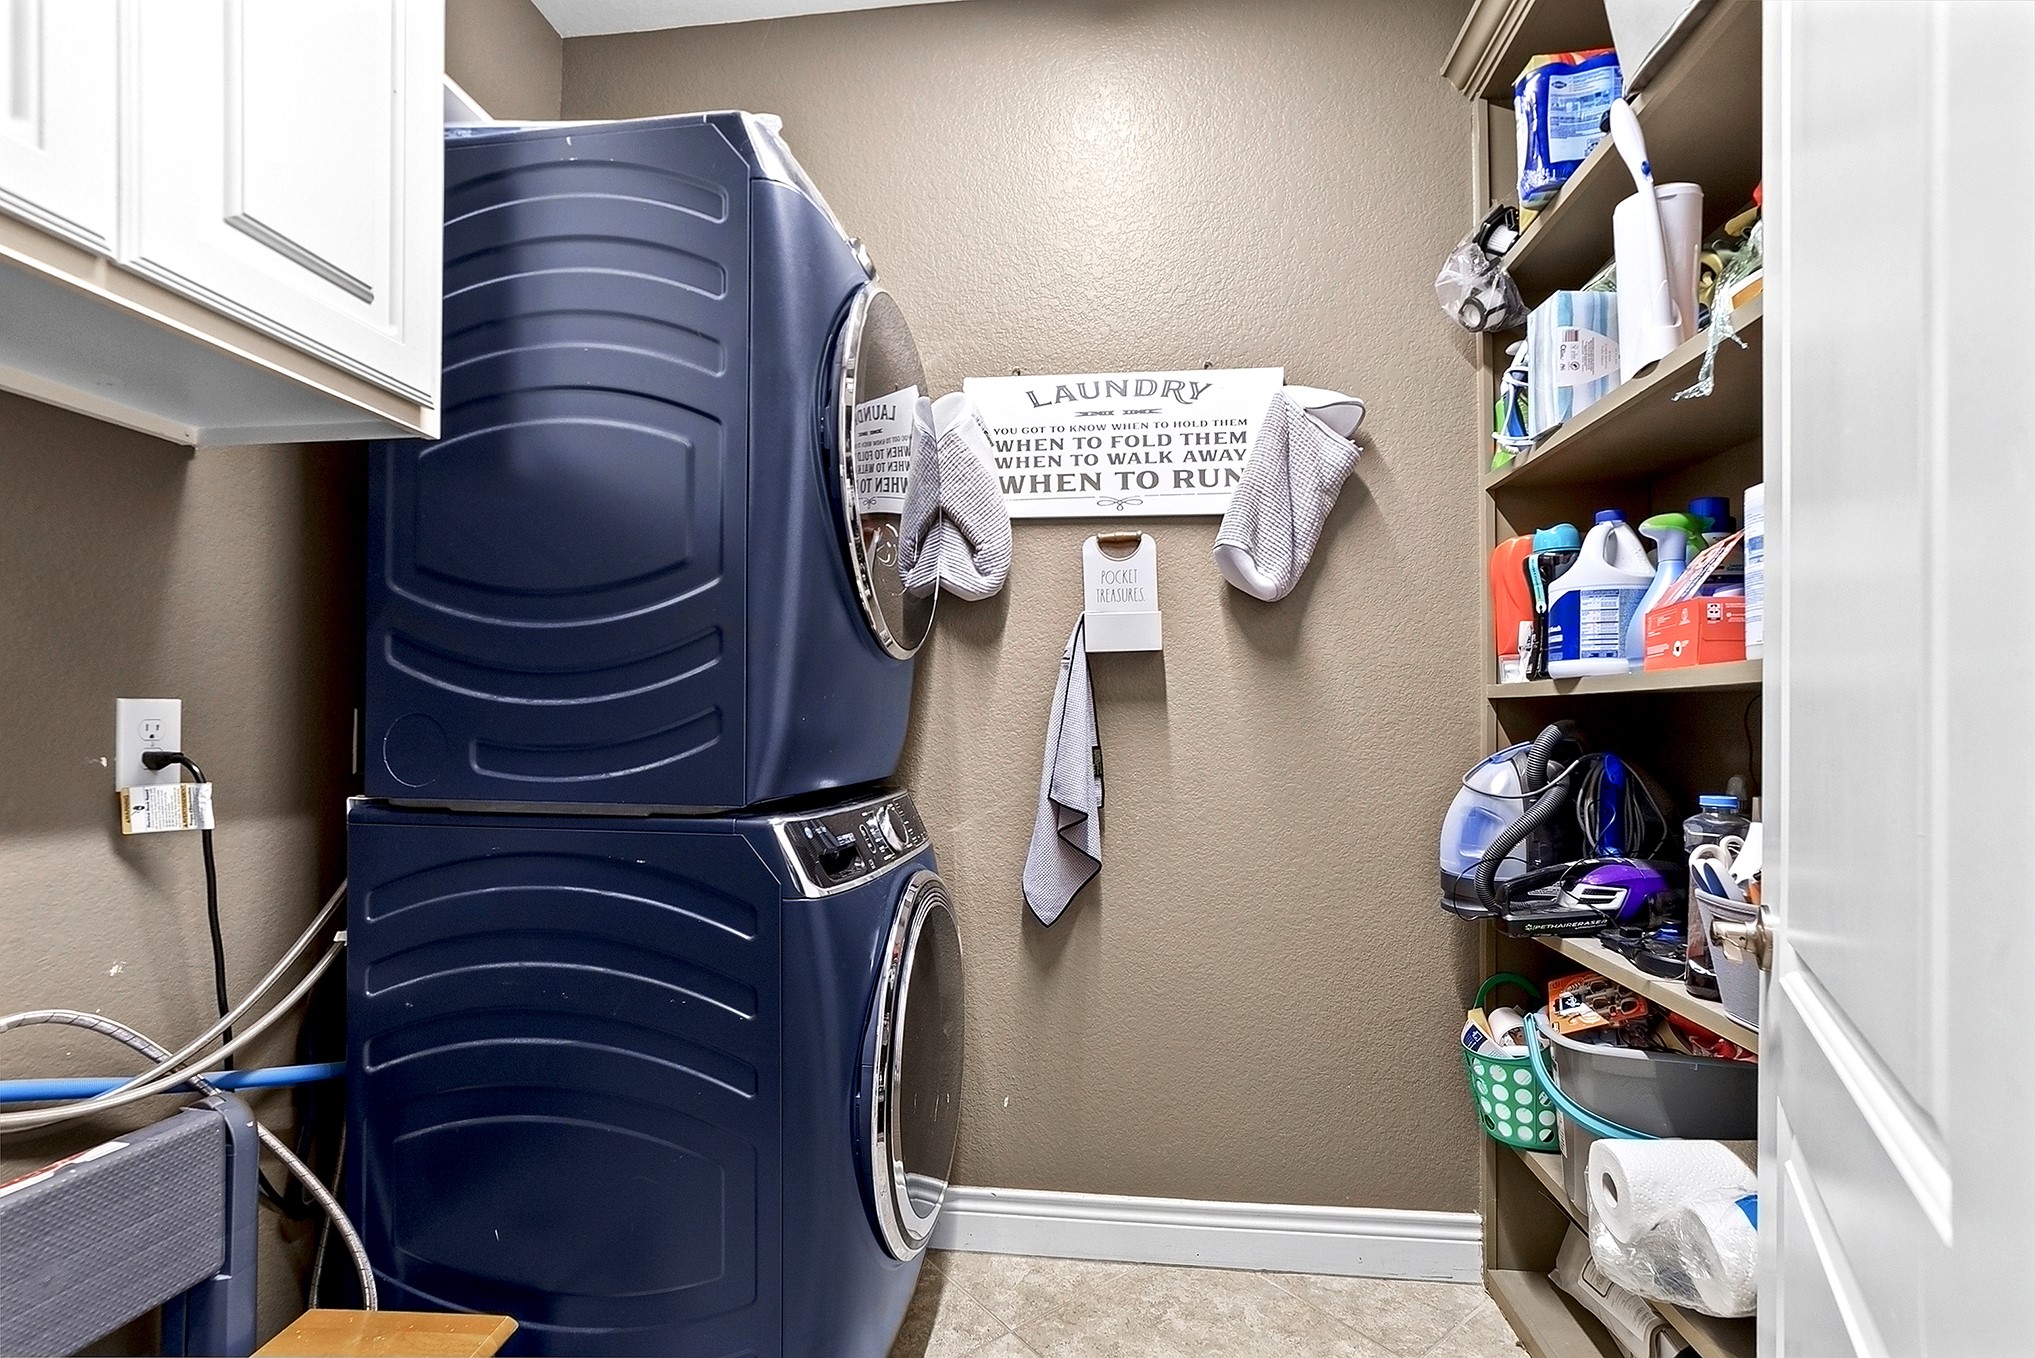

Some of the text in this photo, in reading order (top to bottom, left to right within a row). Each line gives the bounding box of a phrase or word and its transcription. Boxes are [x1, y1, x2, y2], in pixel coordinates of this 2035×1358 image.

[1025, 379, 1213, 408] LAUNDRY
[993, 418, 1248, 436] YOU GOT TO KNOW WHEN TO HOLD THEM
[995, 431, 1247, 453] WHEN TO FOLD THEM
[994, 448, 1247, 469] WHEN TO WALK AWAY
[998, 467, 1245, 494] WHEN TO RUN
[1101, 568, 1138, 585] POCKET
